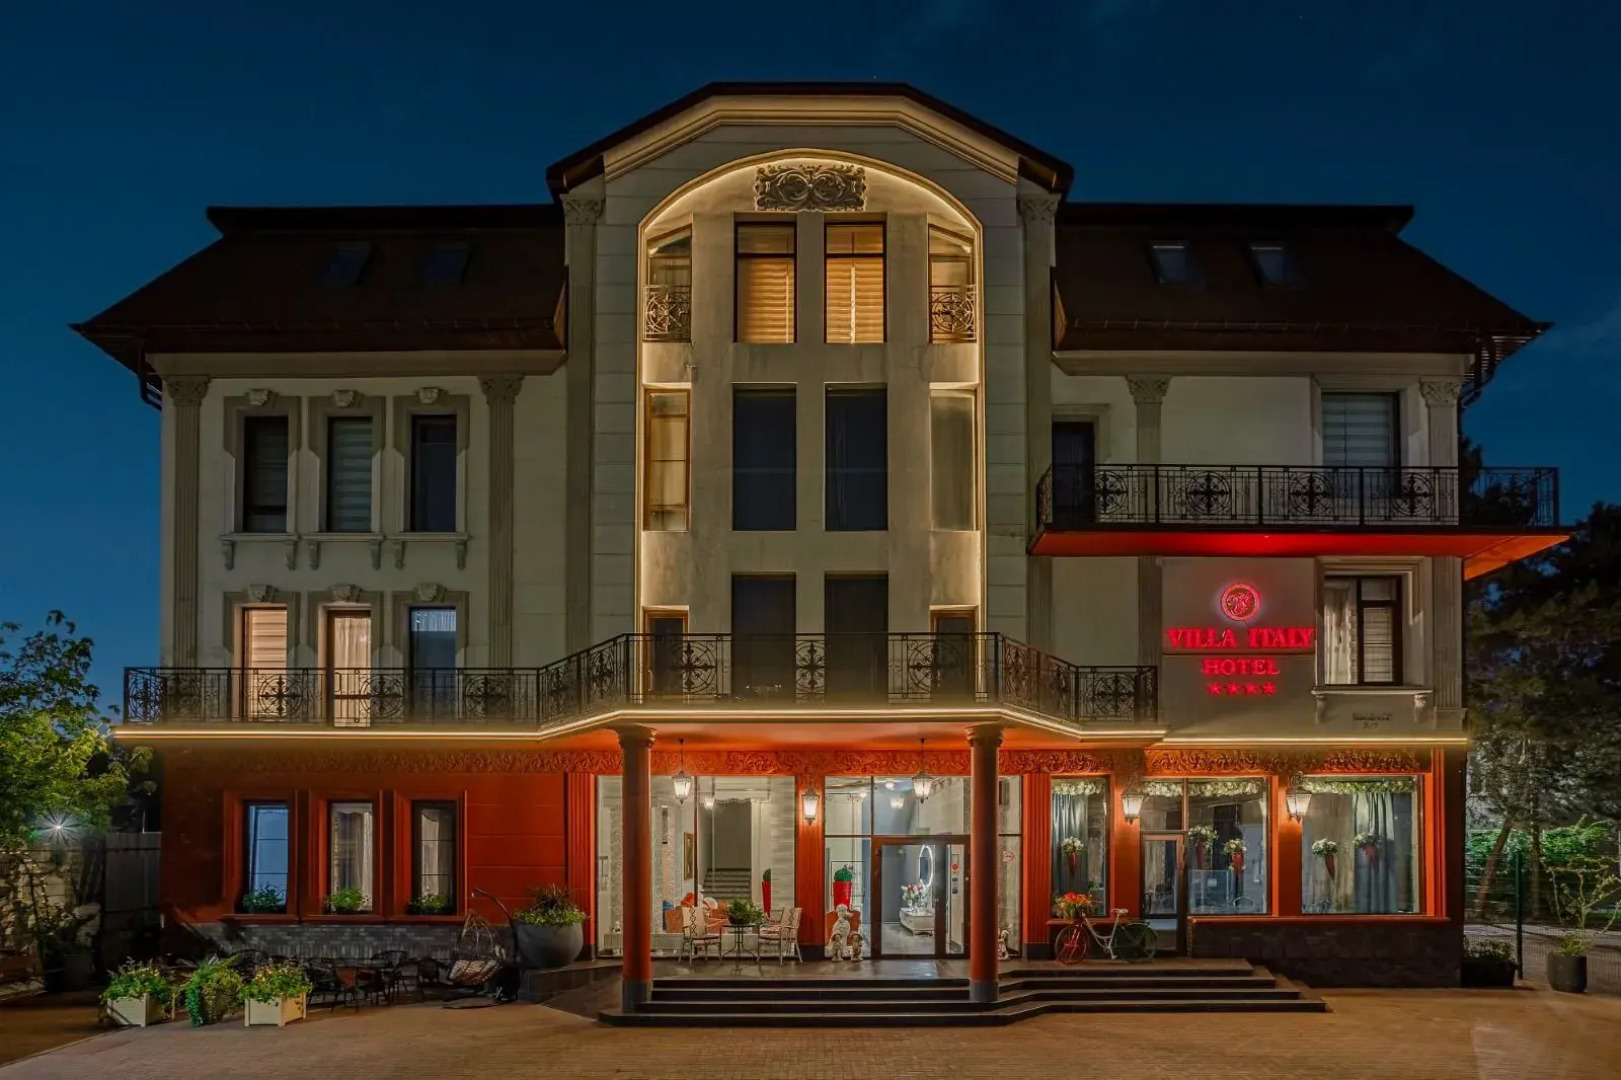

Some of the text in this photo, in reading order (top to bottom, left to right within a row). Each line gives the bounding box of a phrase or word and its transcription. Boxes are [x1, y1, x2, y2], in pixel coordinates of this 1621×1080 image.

[1167, 628, 1314, 648] VILLA ITALY
[1202, 658, 1280, 675] HOTEL
